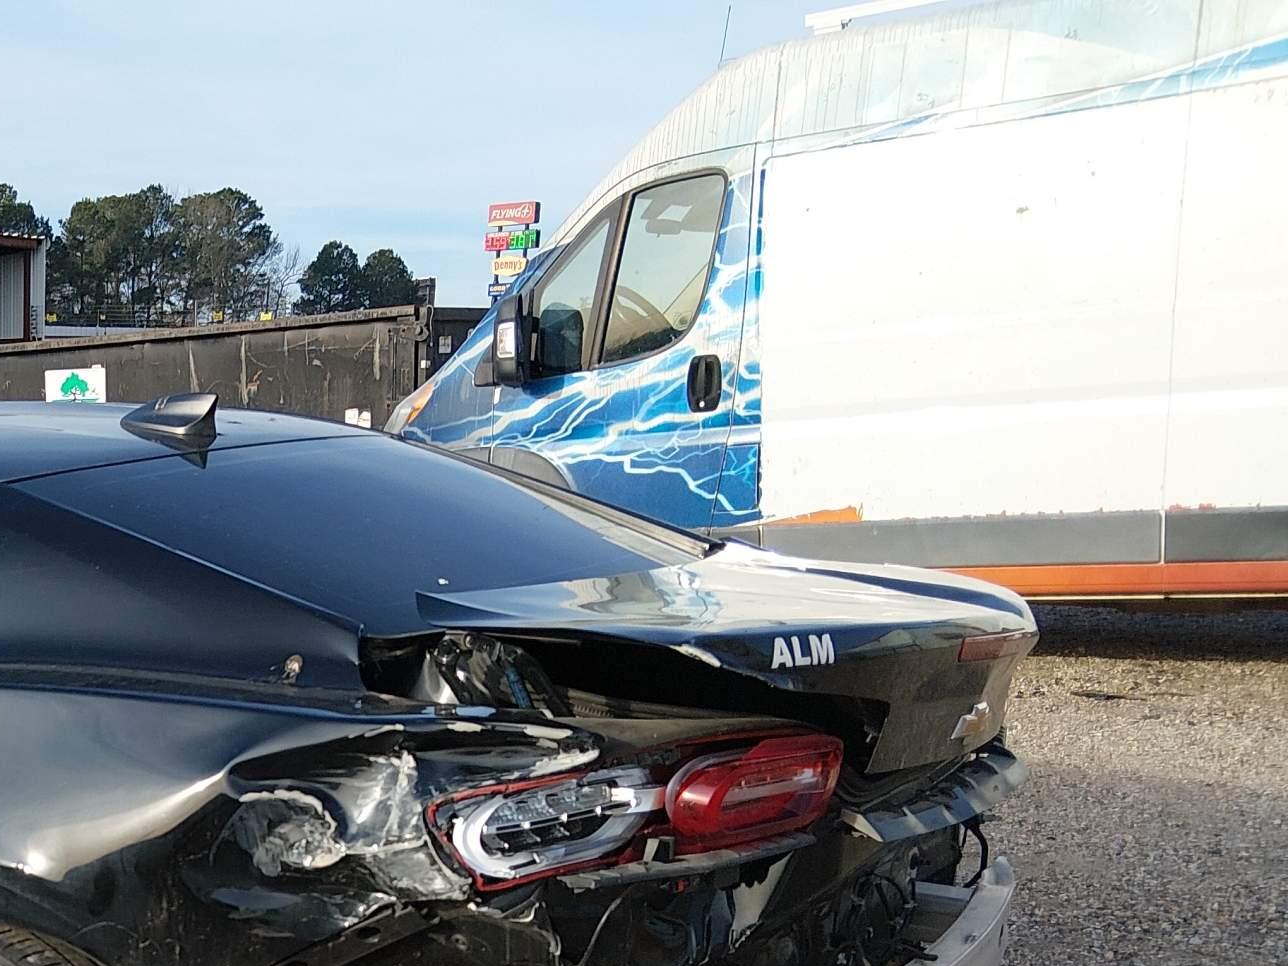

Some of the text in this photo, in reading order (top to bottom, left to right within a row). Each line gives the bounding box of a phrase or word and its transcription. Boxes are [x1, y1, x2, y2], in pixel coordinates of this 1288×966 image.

[491, 208, 521, 220] FLYING
[494, 260, 523, 272] Denny's
[771, 634, 835, 669] ALM
